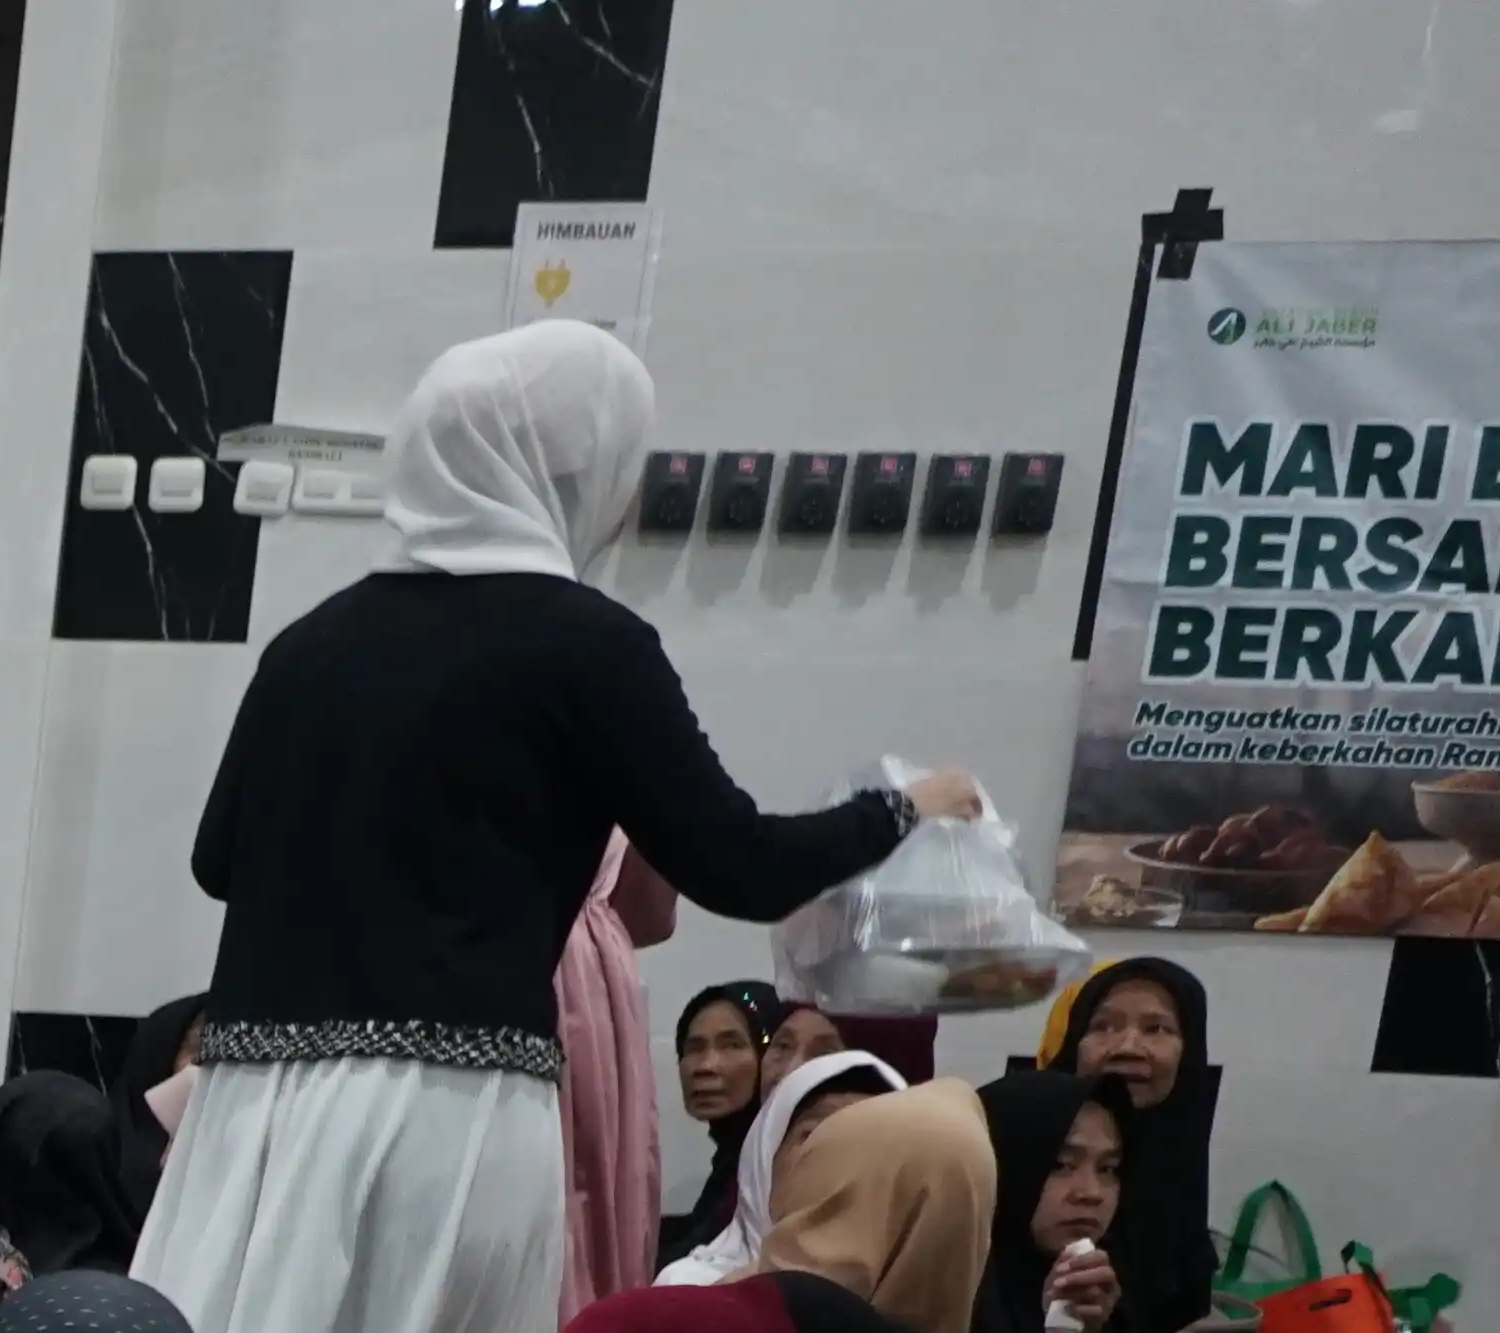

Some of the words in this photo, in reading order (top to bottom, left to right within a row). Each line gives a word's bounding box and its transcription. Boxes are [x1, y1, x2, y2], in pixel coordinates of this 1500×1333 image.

[536, 220, 636, 241] HIMBAUAN
[1180, 422, 1450, 500] MARI
[1164, 515, 1500, 594] BERSA
[1148, 605, 1500, 685] BERKA
[1135, 701, 1341, 733] Menguatkan
[1348, 707, 1500, 737] silaturah
[1129, 735, 1231, 760] dalam
[1238, 738, 1434, 767] keberkahan
